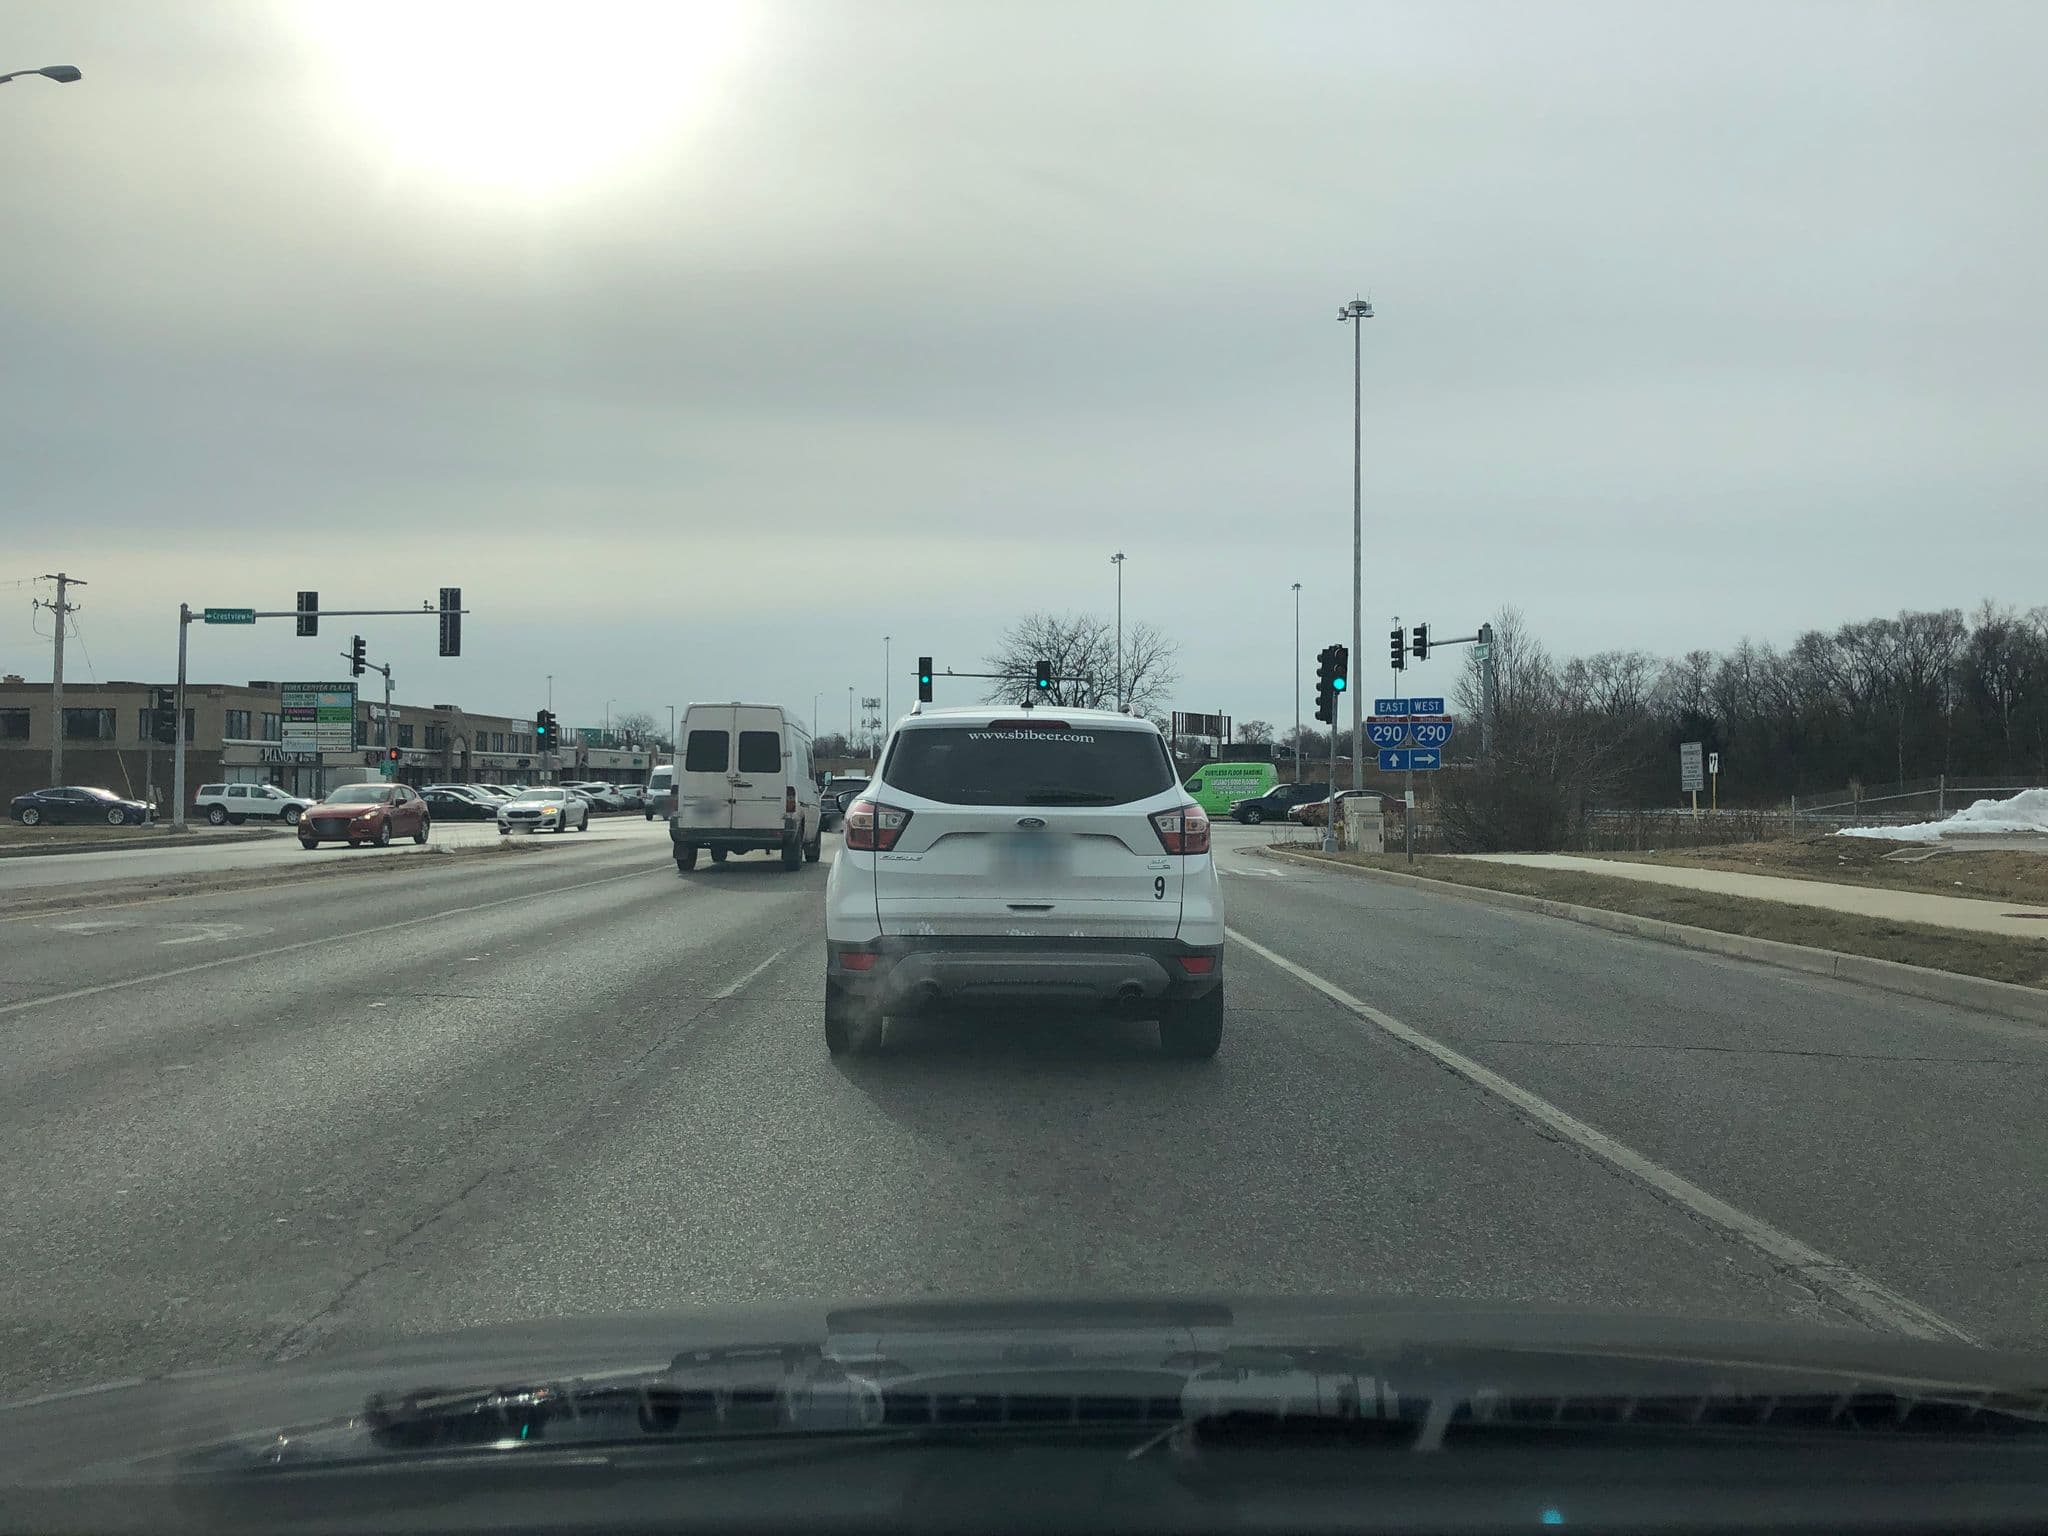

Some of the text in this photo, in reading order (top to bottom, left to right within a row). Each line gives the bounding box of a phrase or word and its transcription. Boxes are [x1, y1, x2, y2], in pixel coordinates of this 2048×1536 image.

[1379, 702, 1404, 712] EAST
[1414, 701, 1440, 711] WEST
[968, 730, 1095, 742] www.sbibeer.com
[1373, 726, 1402, 741] 290
[1417, 726, 1446, 741] 290
[1153, 875, 1166, 900] 9
